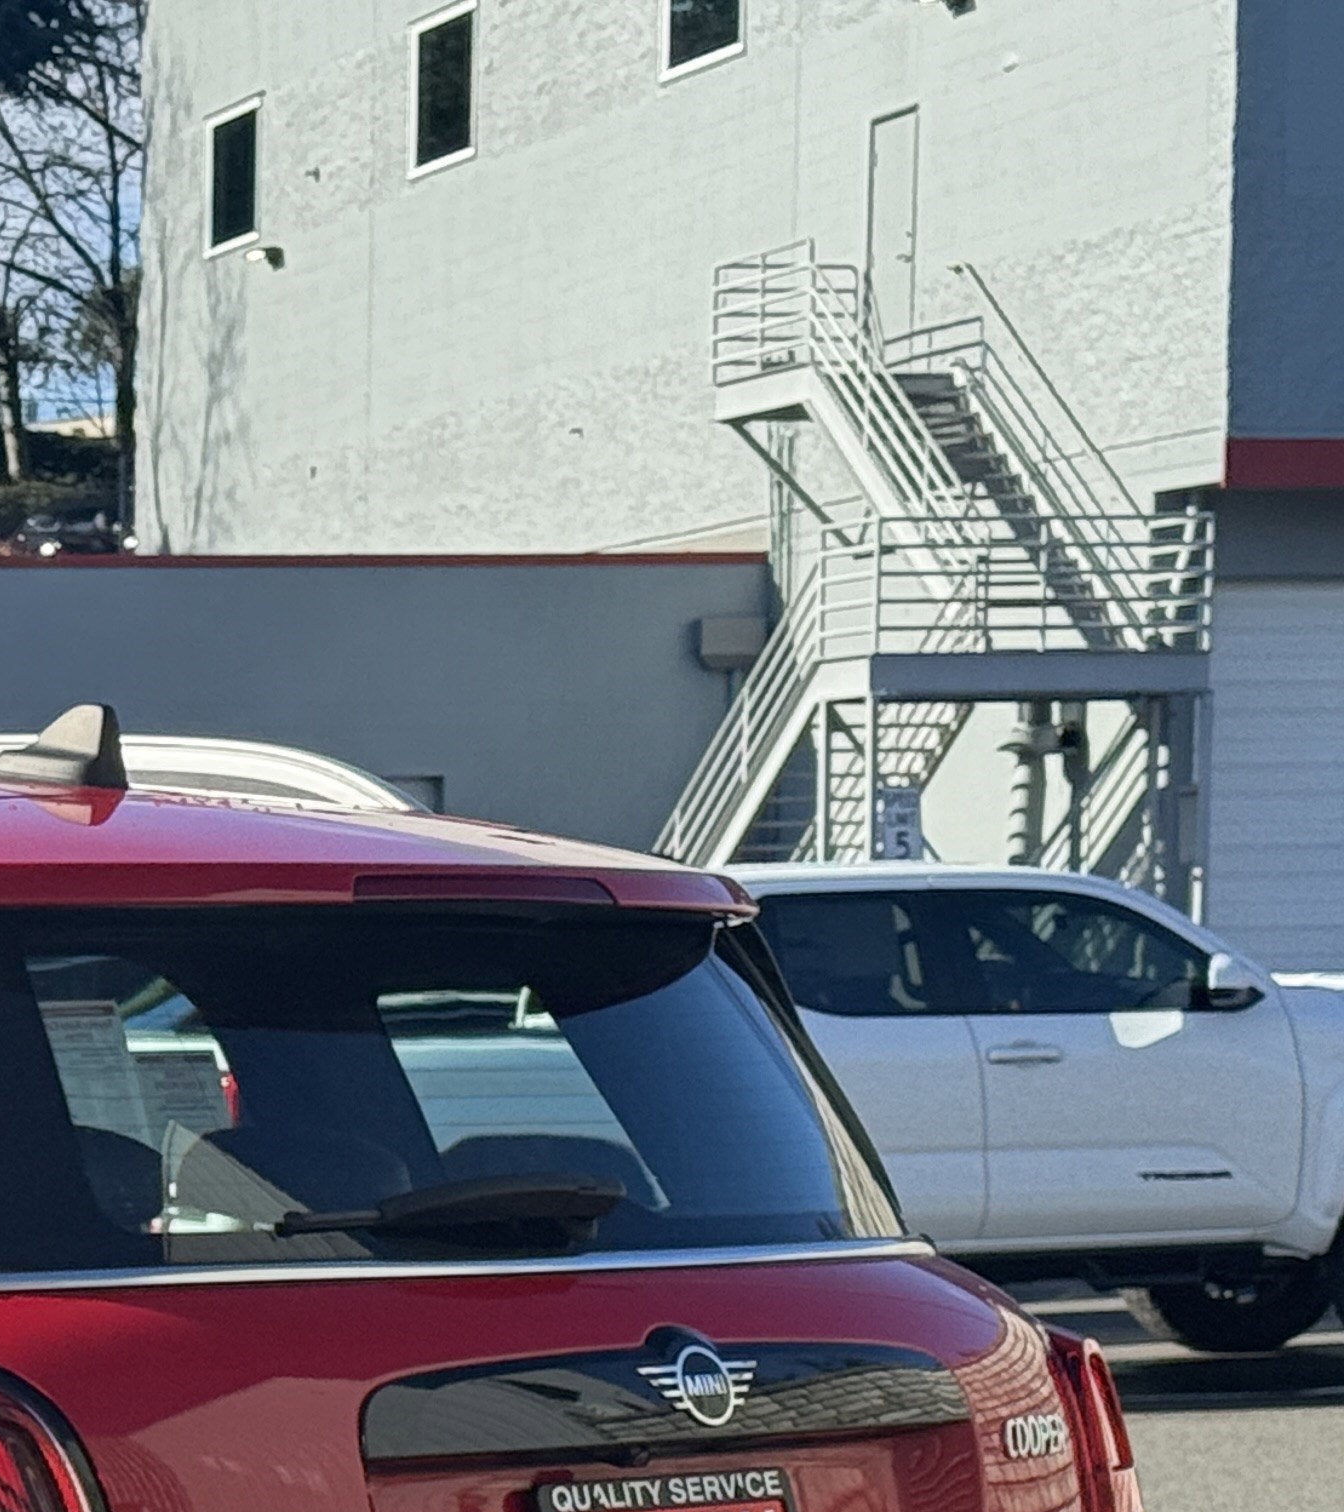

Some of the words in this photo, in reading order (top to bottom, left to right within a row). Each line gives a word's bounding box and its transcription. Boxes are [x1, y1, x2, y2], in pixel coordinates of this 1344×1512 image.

[684, 1372, 728, 1397] MINI
[1005, 1413, 1068, 1459] COOPER
[551, 1478, 662, 1512] QUALITY
[668, 1470, 784, 1504] SERVICE
